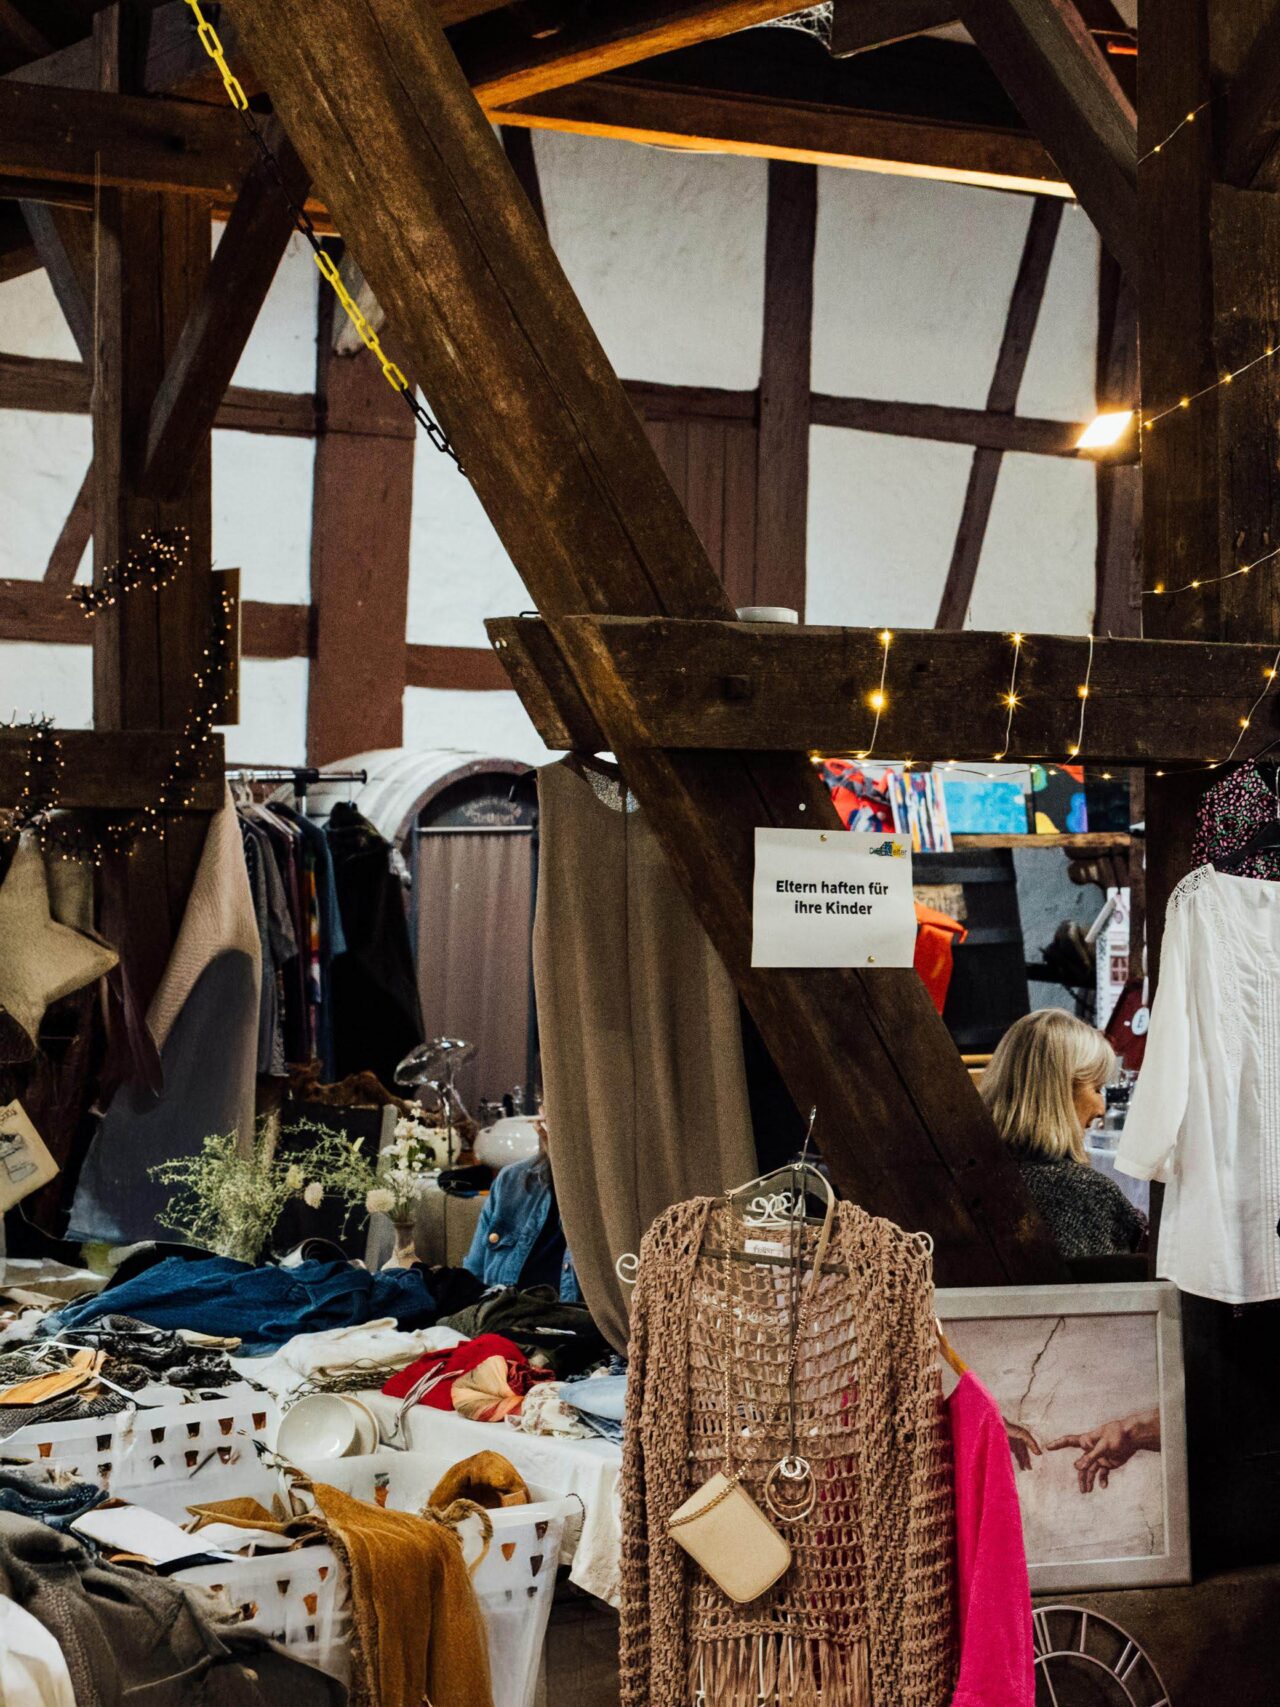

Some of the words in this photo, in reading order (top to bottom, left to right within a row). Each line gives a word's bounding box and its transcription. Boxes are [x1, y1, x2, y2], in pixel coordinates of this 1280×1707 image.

[776, 880, 817, 893] Eltern
[821, 881, 865, 895] haften
[868, 882, 889, 895] für
[795, 900, 822, 914] ihre
[825, 901, 873, 915] Kinder
